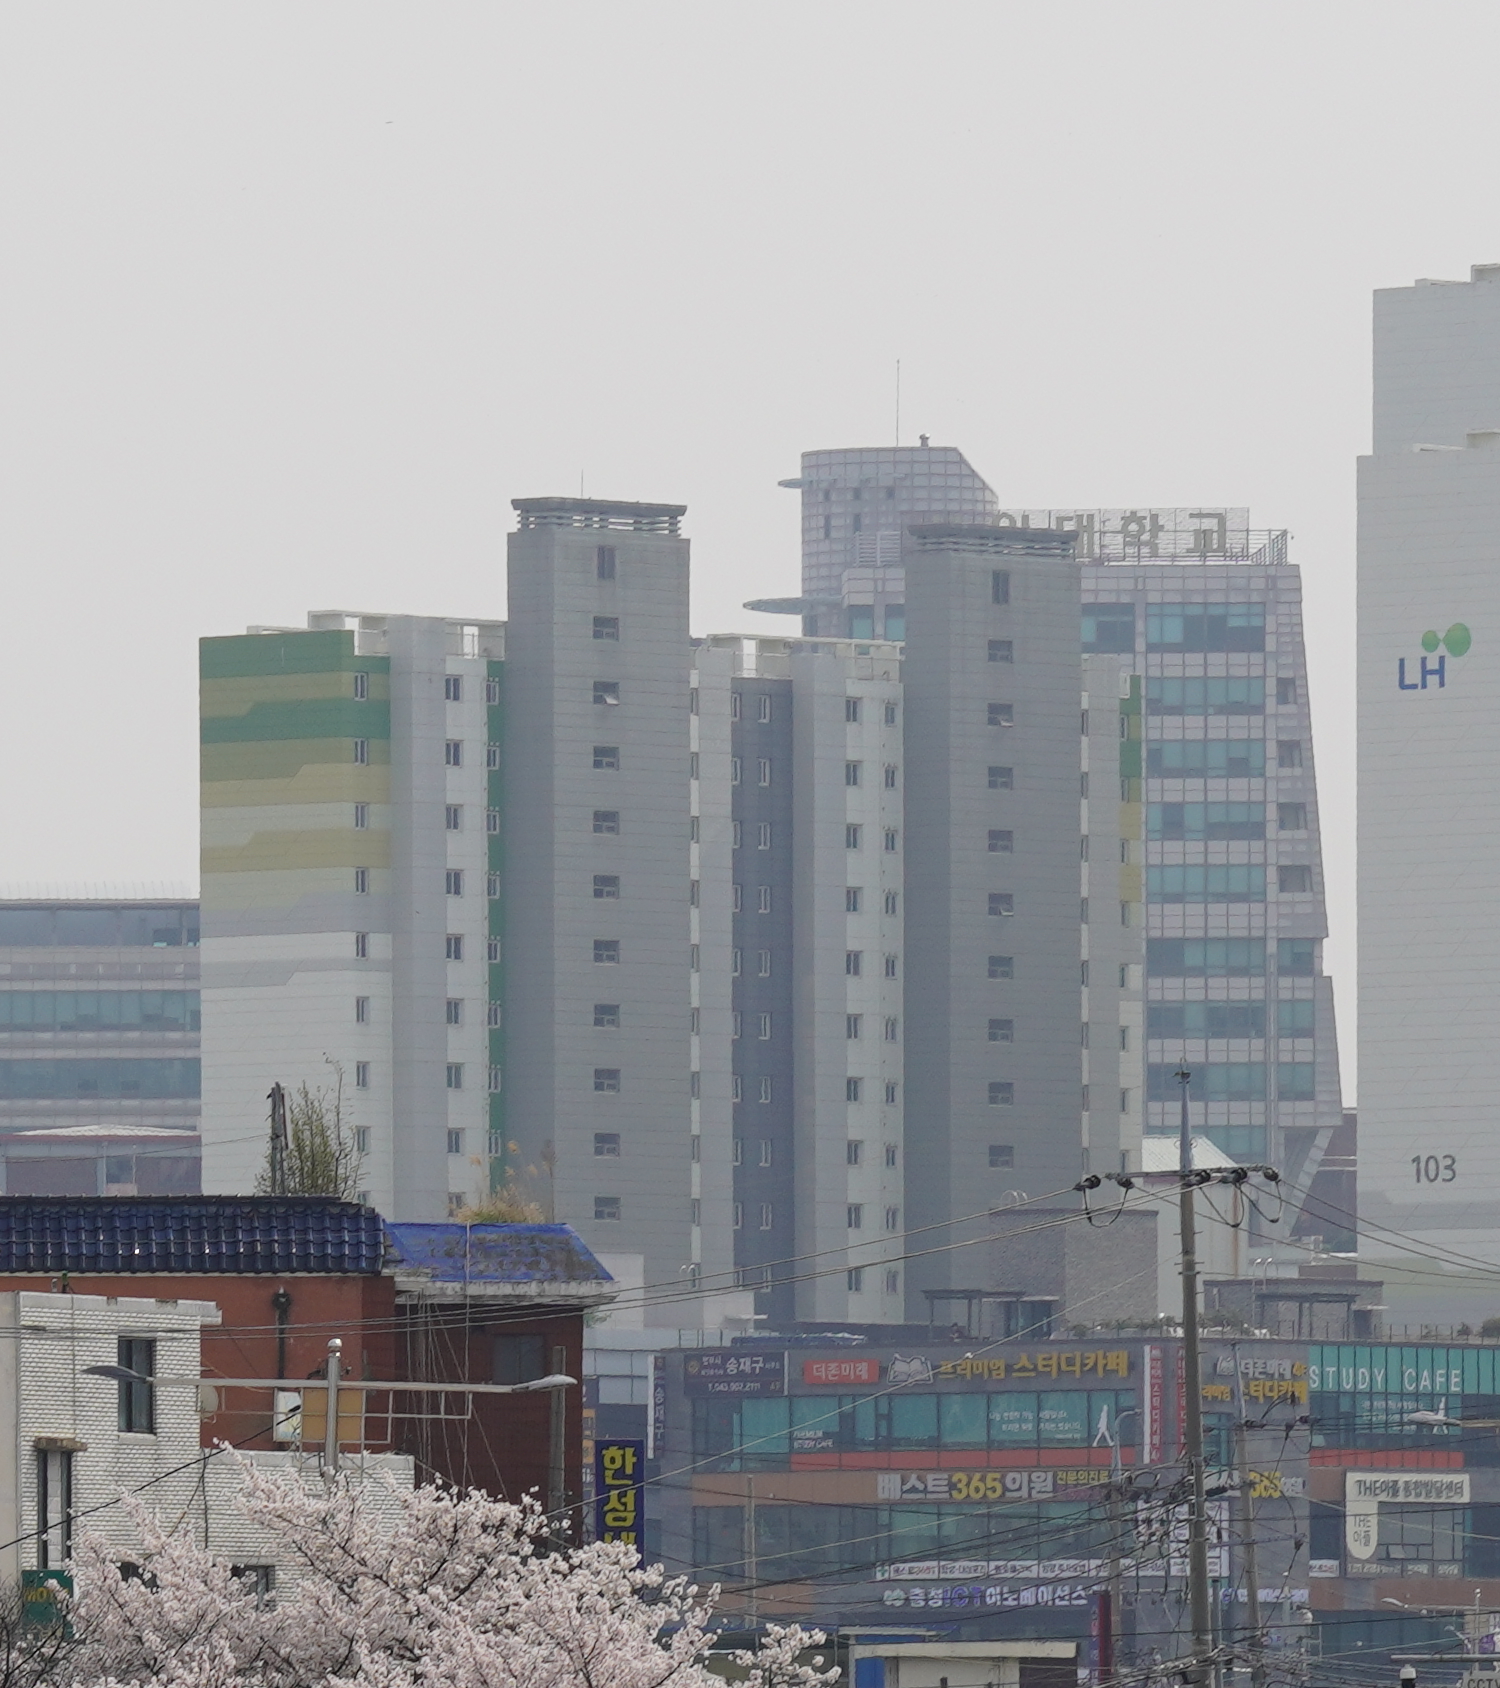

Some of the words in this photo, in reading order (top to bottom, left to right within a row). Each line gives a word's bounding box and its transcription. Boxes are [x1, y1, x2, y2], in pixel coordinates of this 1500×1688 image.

[1399, 656, 1445, 689] LH
[1411, 1155, 1456, 1184] 103
[726, 1357, 764, 1375] 송재구
[1012, 1350, 1129, 1379] 스터디카페
[1309, 1365, 1386, 1390] STUDY
[1404, 1368, 1461, 1392] CAFE
[877, 1471, 1054, 1500] 베스트365의원
